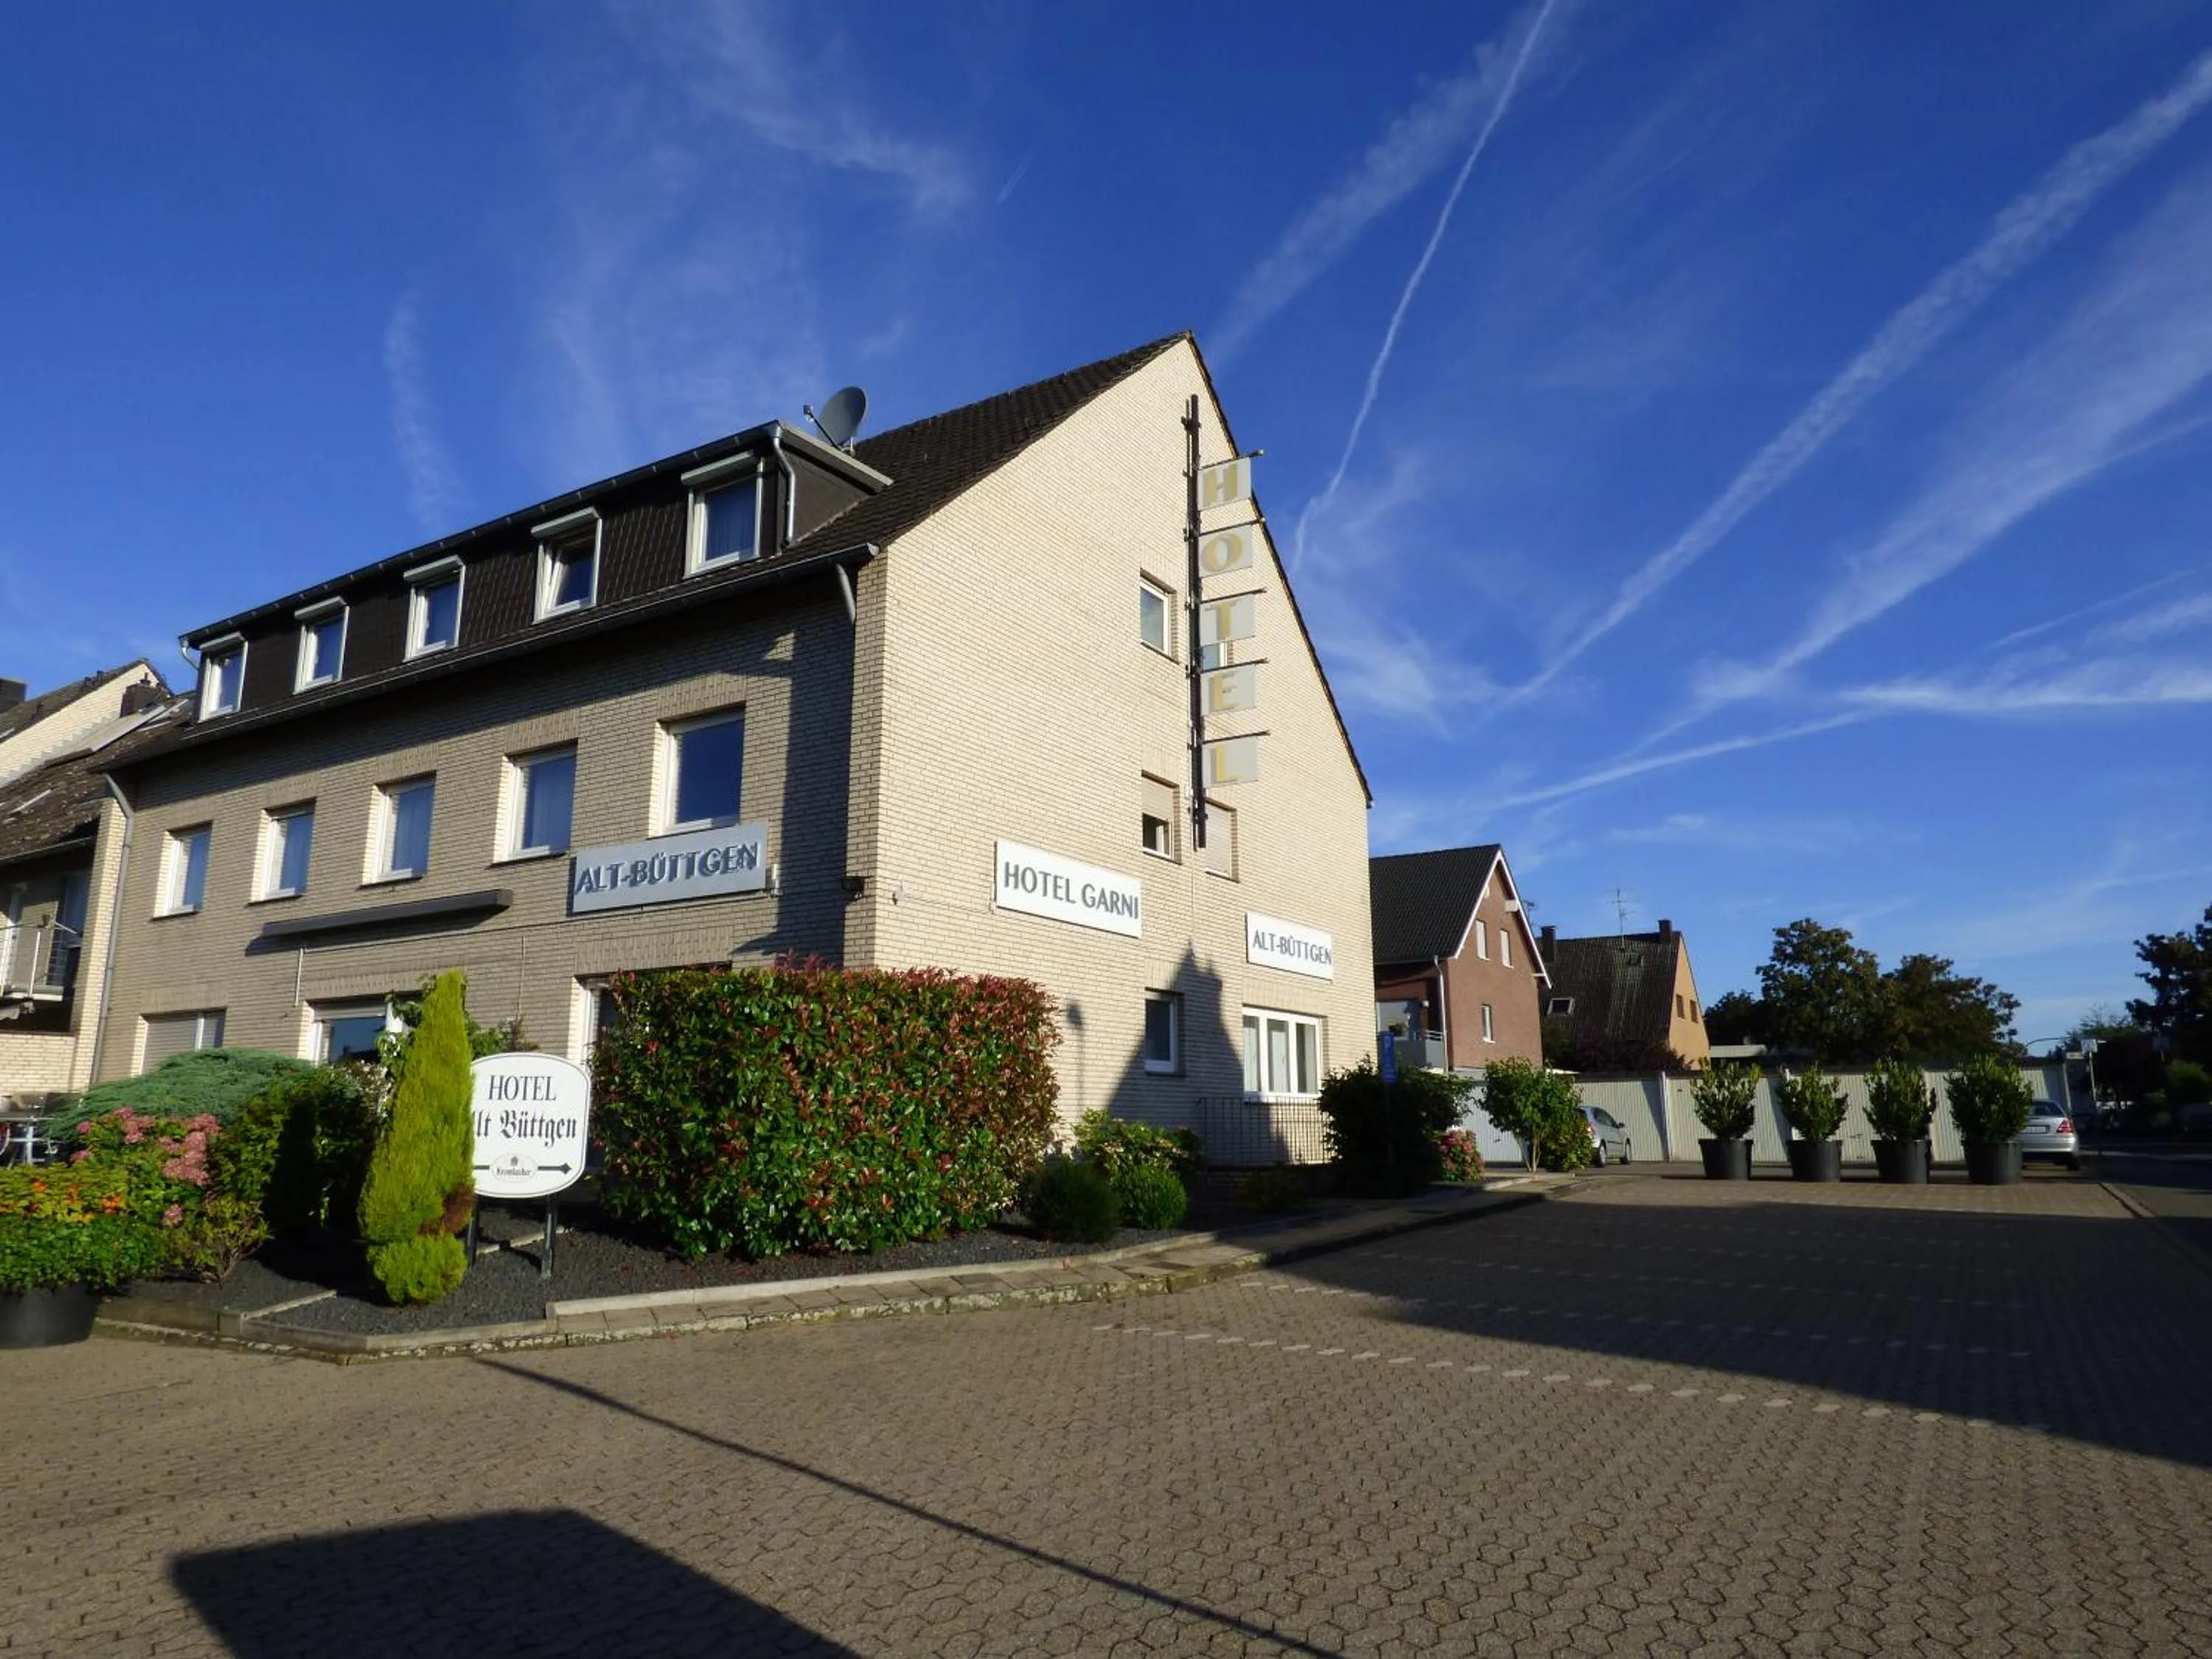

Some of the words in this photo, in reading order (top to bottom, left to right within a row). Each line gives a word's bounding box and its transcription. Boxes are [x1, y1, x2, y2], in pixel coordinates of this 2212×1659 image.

[1201, 462, 1242, 784] HOTEL
[574, 842, 759, 895] ALT-BÜTTGEN
[1004, 861, 1077, 905] HOTEL
[1081, 883, 1139, 919] GARNI
[1253, 928, 1332, 965] ALT-BÜTTGEN
[488, 1075, 557, 1101] HOTEL
[473, 1109, 491, 1138] lt
[500, 1110, 577, 1147] Büttgen
